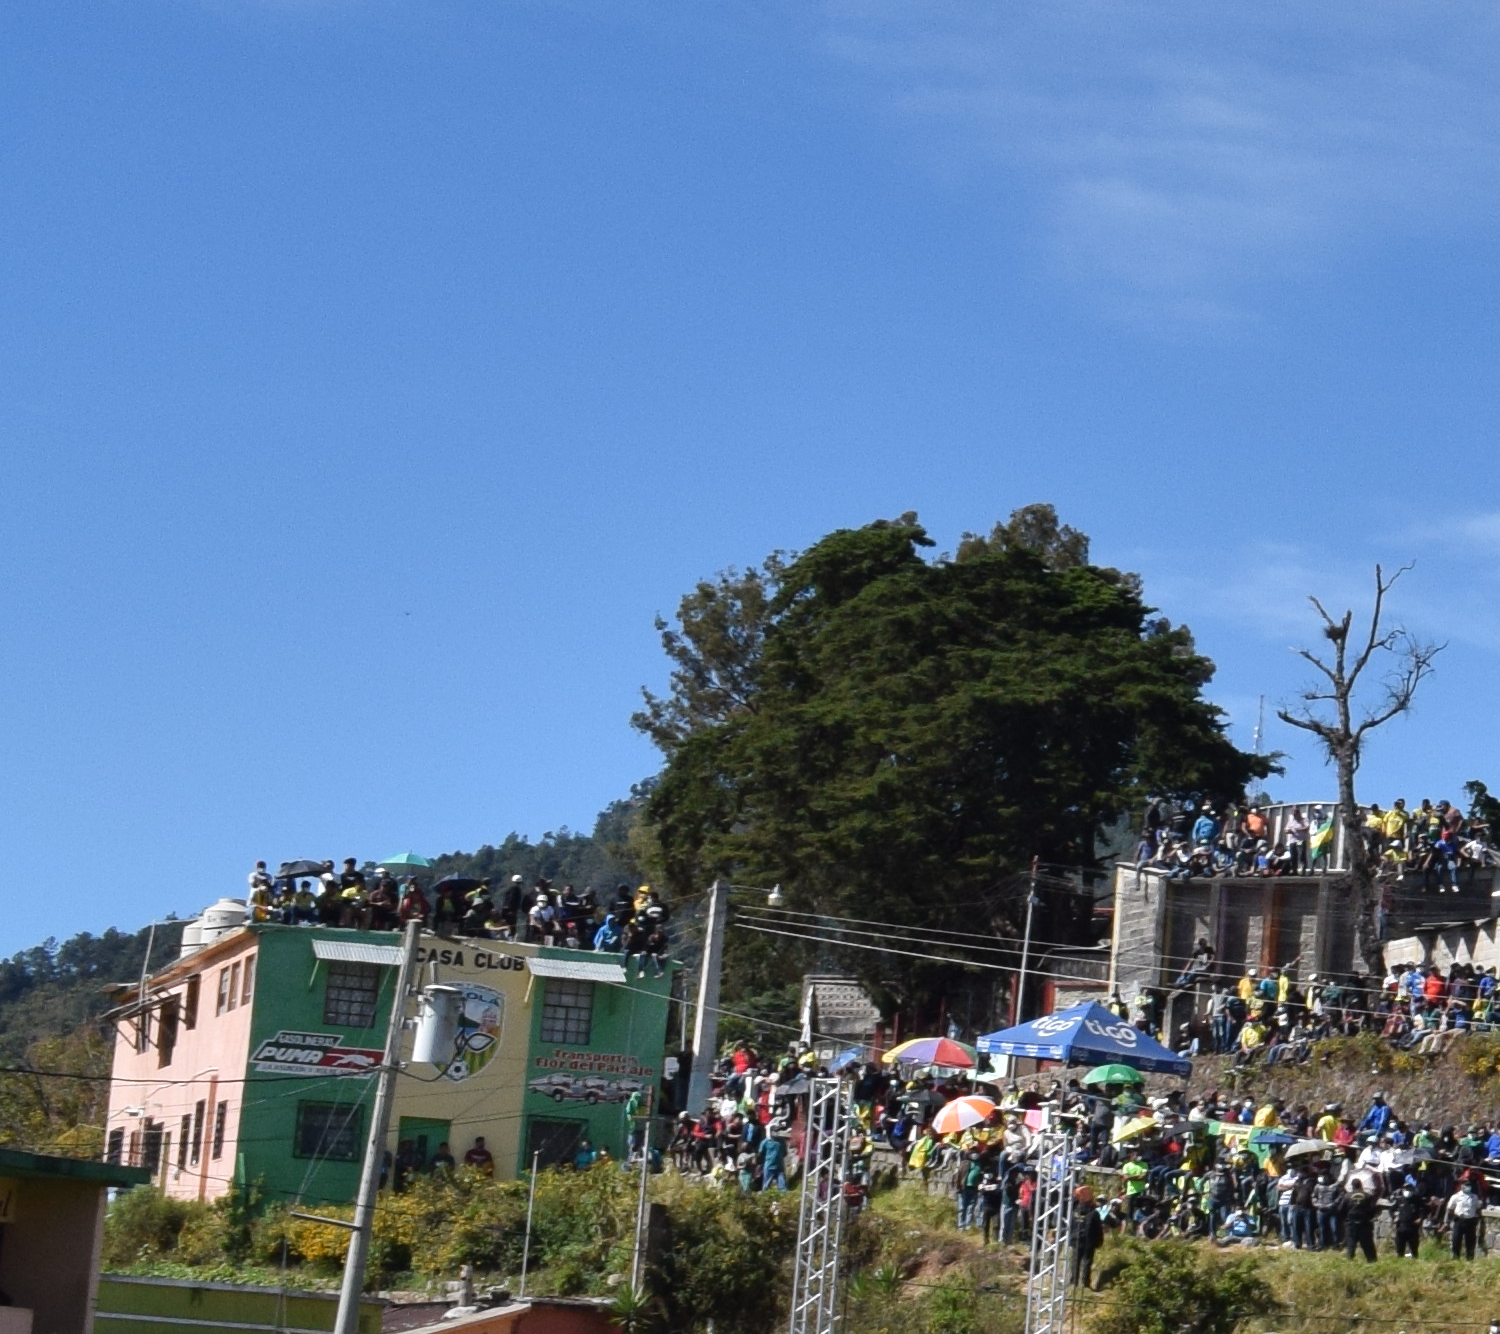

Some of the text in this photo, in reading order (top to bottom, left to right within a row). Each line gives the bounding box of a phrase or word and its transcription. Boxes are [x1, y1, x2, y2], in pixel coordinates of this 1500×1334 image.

[415, 948, 526, 971] CASA CLUB
[257, 1046, 324, 1064] PUMA
